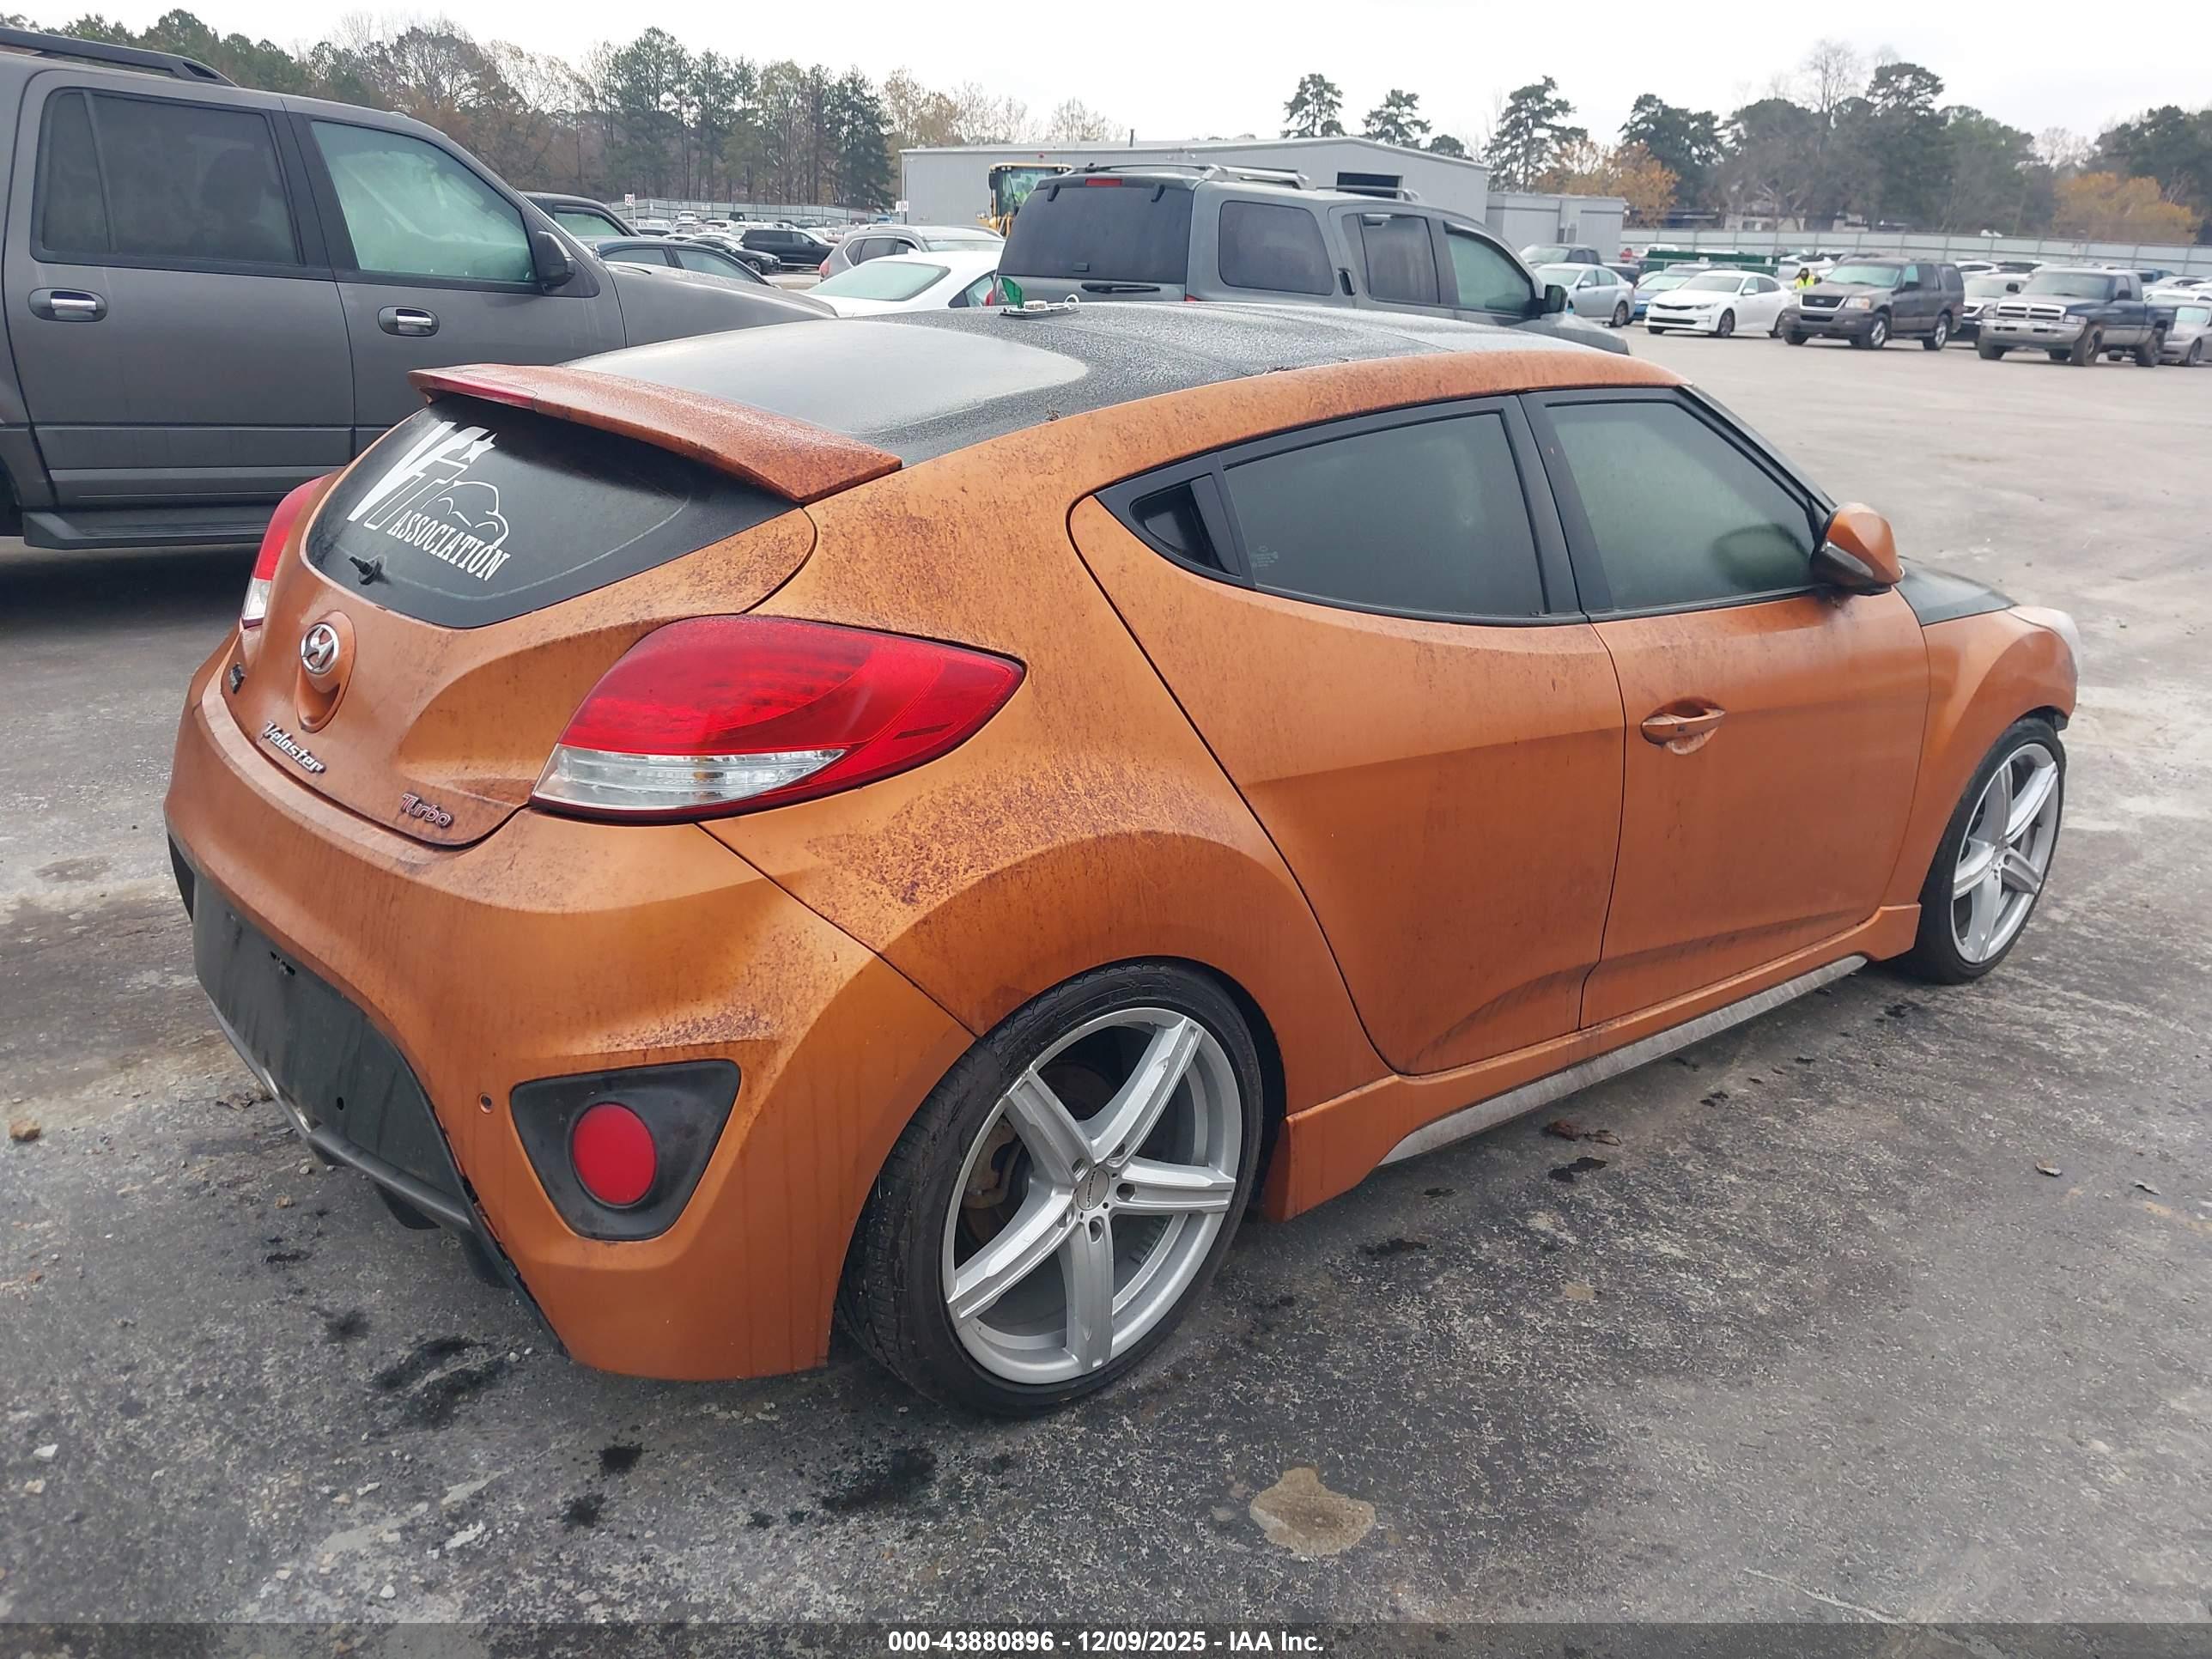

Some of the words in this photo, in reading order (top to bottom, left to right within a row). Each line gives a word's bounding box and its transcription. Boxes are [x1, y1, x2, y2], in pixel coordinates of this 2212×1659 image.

[386, 510, 512, 582] ASSOCIATION
[262, 720, 325, 774] Veloster
[401, 793, 453, 828] Turbo
